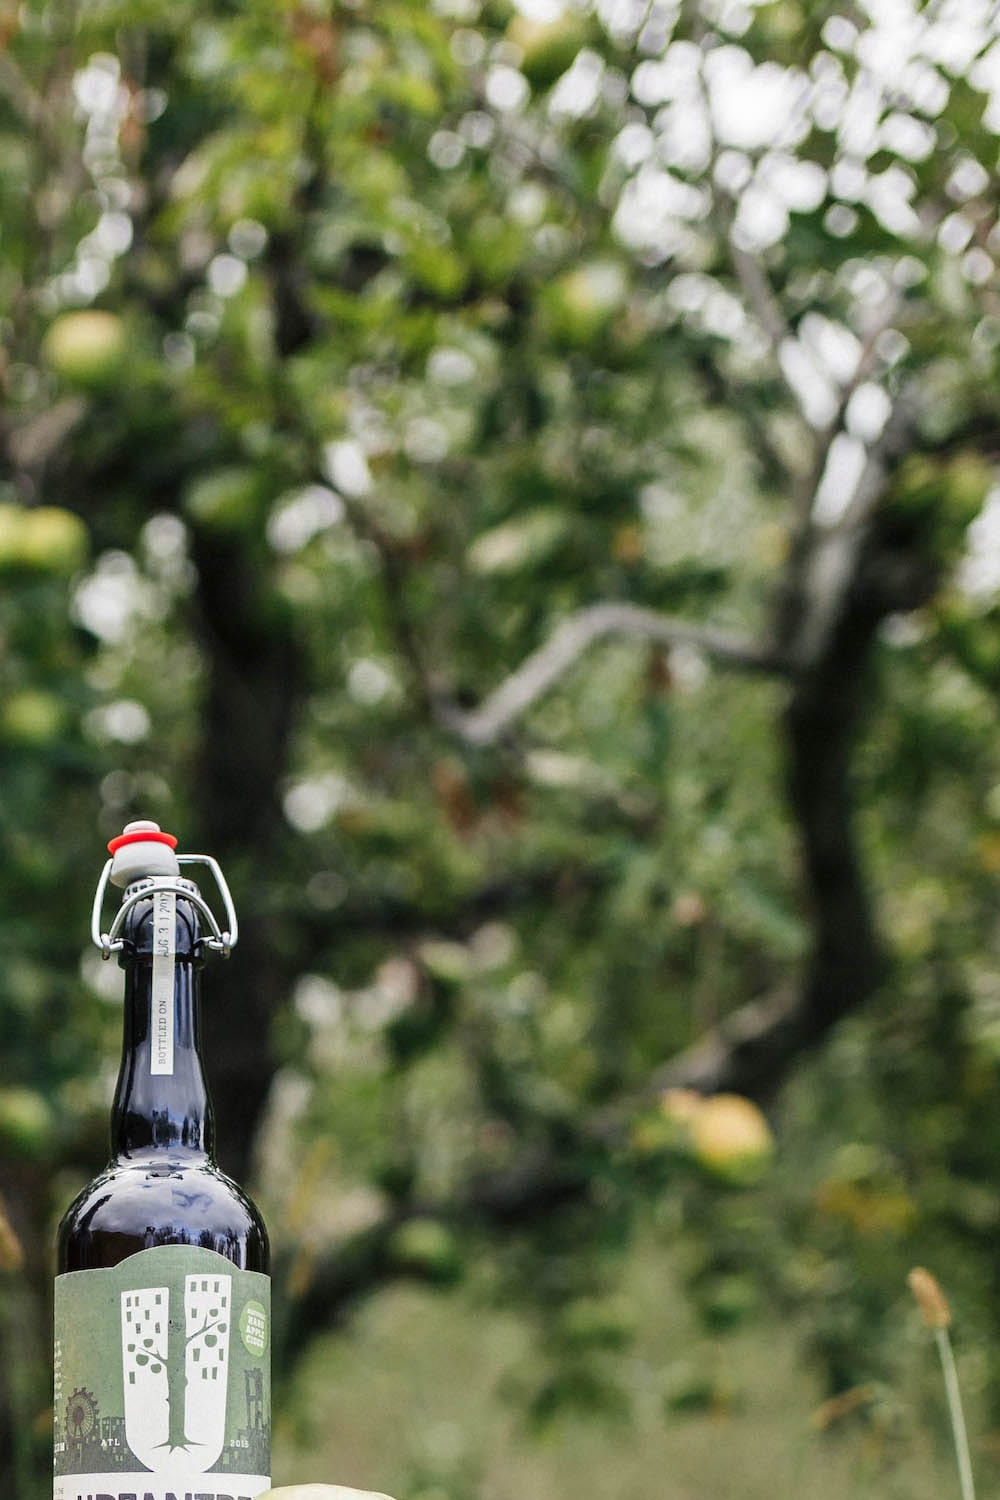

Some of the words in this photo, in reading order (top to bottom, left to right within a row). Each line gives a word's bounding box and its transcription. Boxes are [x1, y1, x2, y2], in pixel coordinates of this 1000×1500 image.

[157, 940, 170, 958] AUG
[158, 1000, 168, 1015] ON
[158, 1018, 168, 1065] BOTTLED
[100, 1439, 121, 1447] ATL
[229, 1439, 250, 1448] 2015
